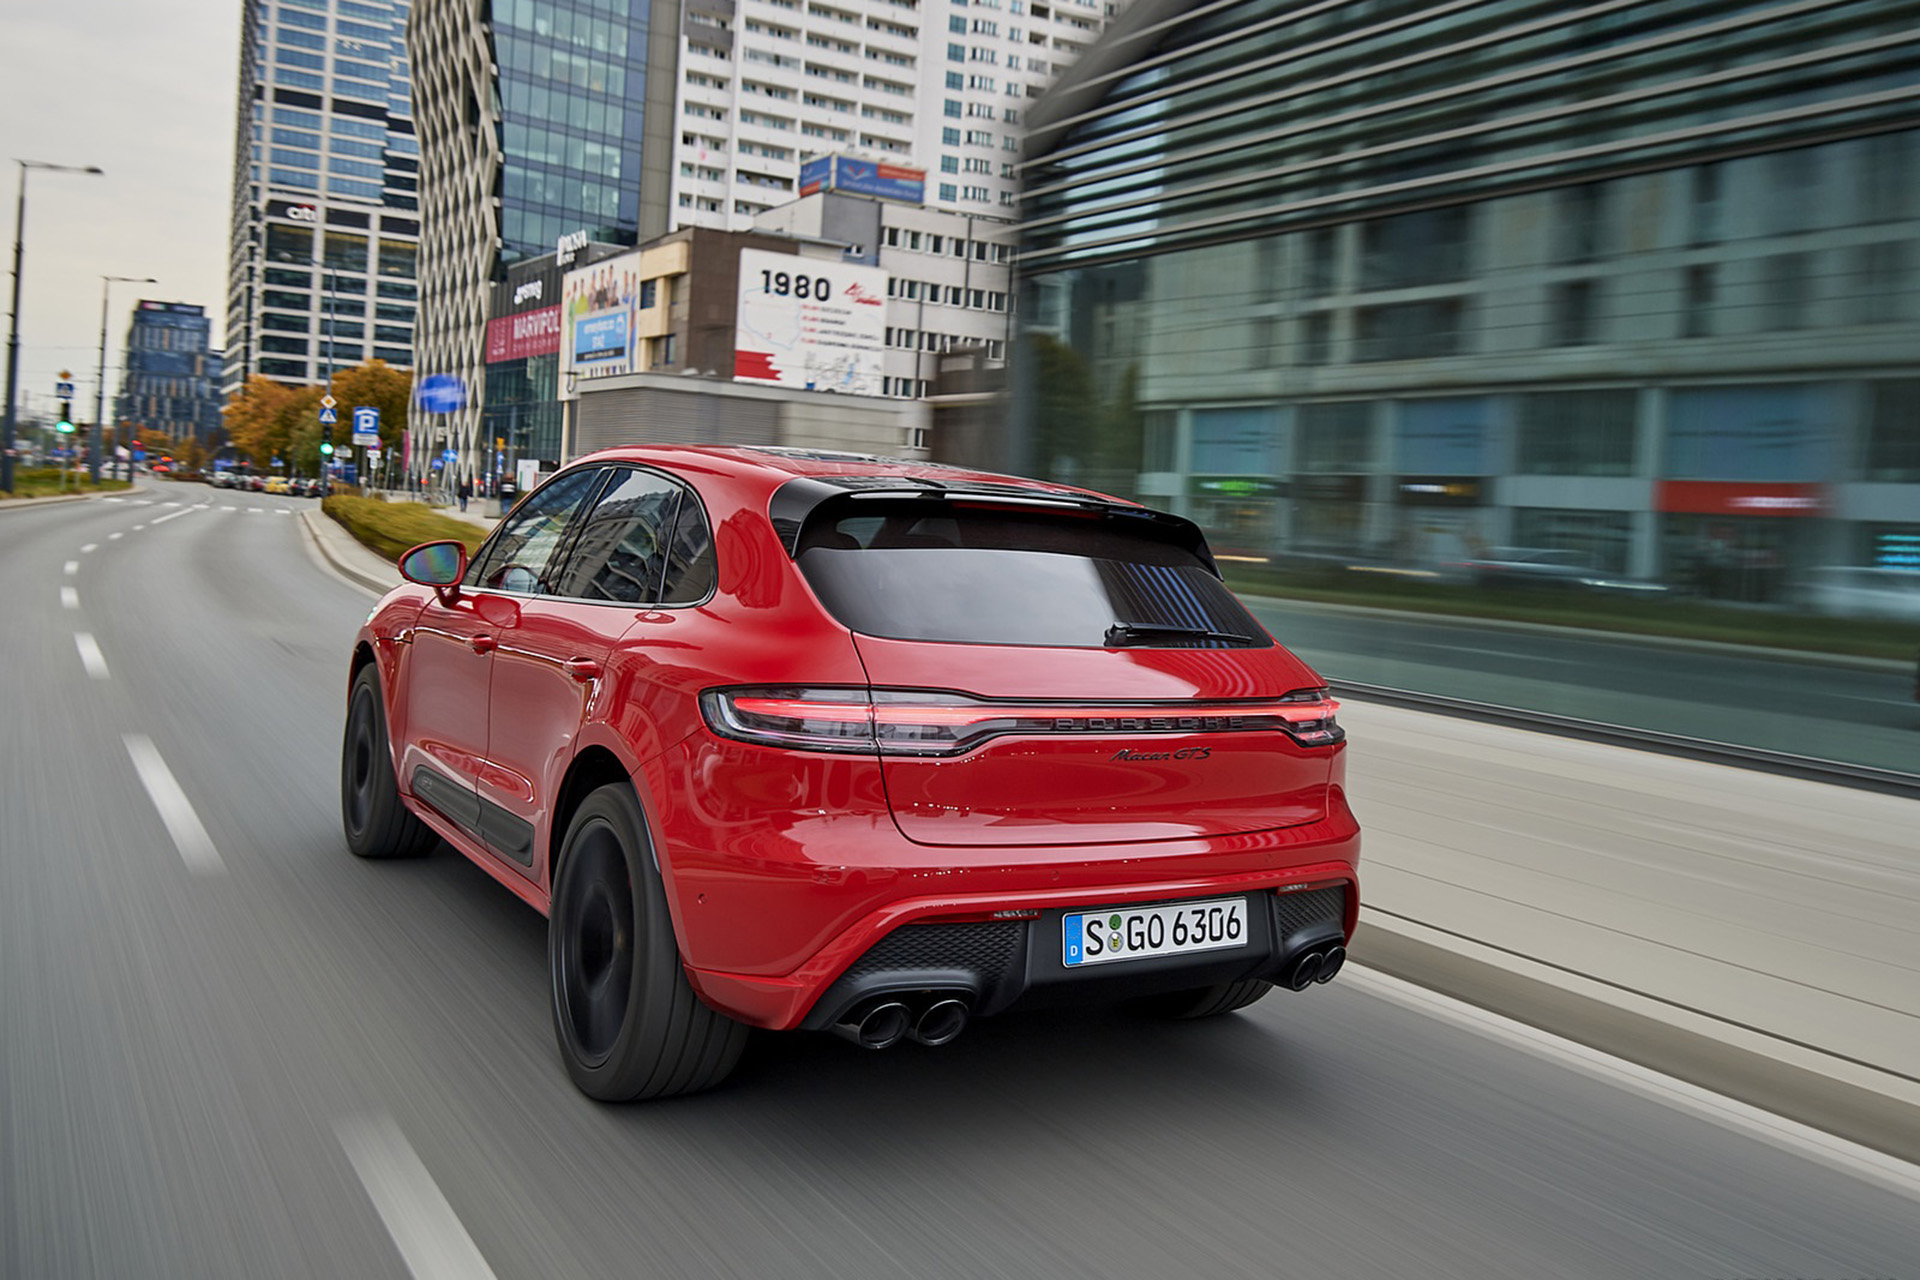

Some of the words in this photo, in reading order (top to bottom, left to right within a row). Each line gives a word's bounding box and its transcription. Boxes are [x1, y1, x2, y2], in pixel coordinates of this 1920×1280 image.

[286, 205, 318, 221] citi
[761, 269, 830, 302] 1980
[513, 309, 560, 340] MARVIPOL
[359, 415, 375, 432] P
[1055, 716, 1243, 730] PORSCHE
[1109, 749, 1170, 762] Macan
[1173, 747, 1212, 760] GTS
[1086, 920, 1104, 956] S
[1127, 913, 1164, 951] GO
[1172, 906, 1241, 946] 6306
[1070, 945, 1078, 957] D
